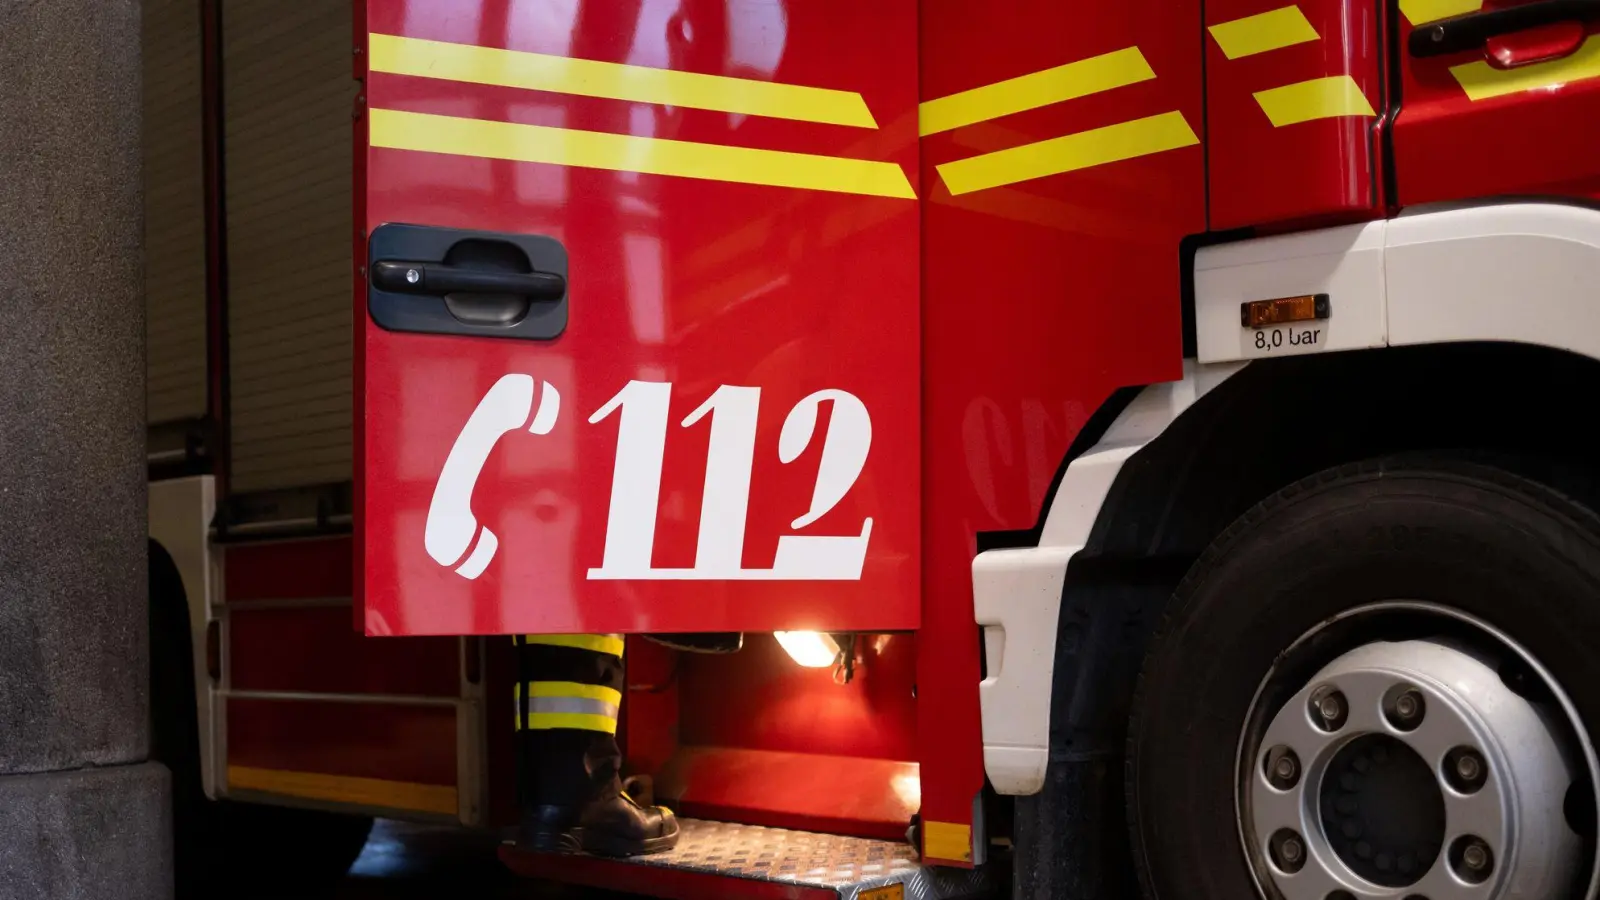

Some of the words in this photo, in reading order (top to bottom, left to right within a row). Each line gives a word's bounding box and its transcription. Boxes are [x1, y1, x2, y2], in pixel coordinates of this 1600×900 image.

[1255, 329, 1283, 351] 8,0
[1289, 327, 1321, 346] bar
[586, 380, 873, 581] 112
